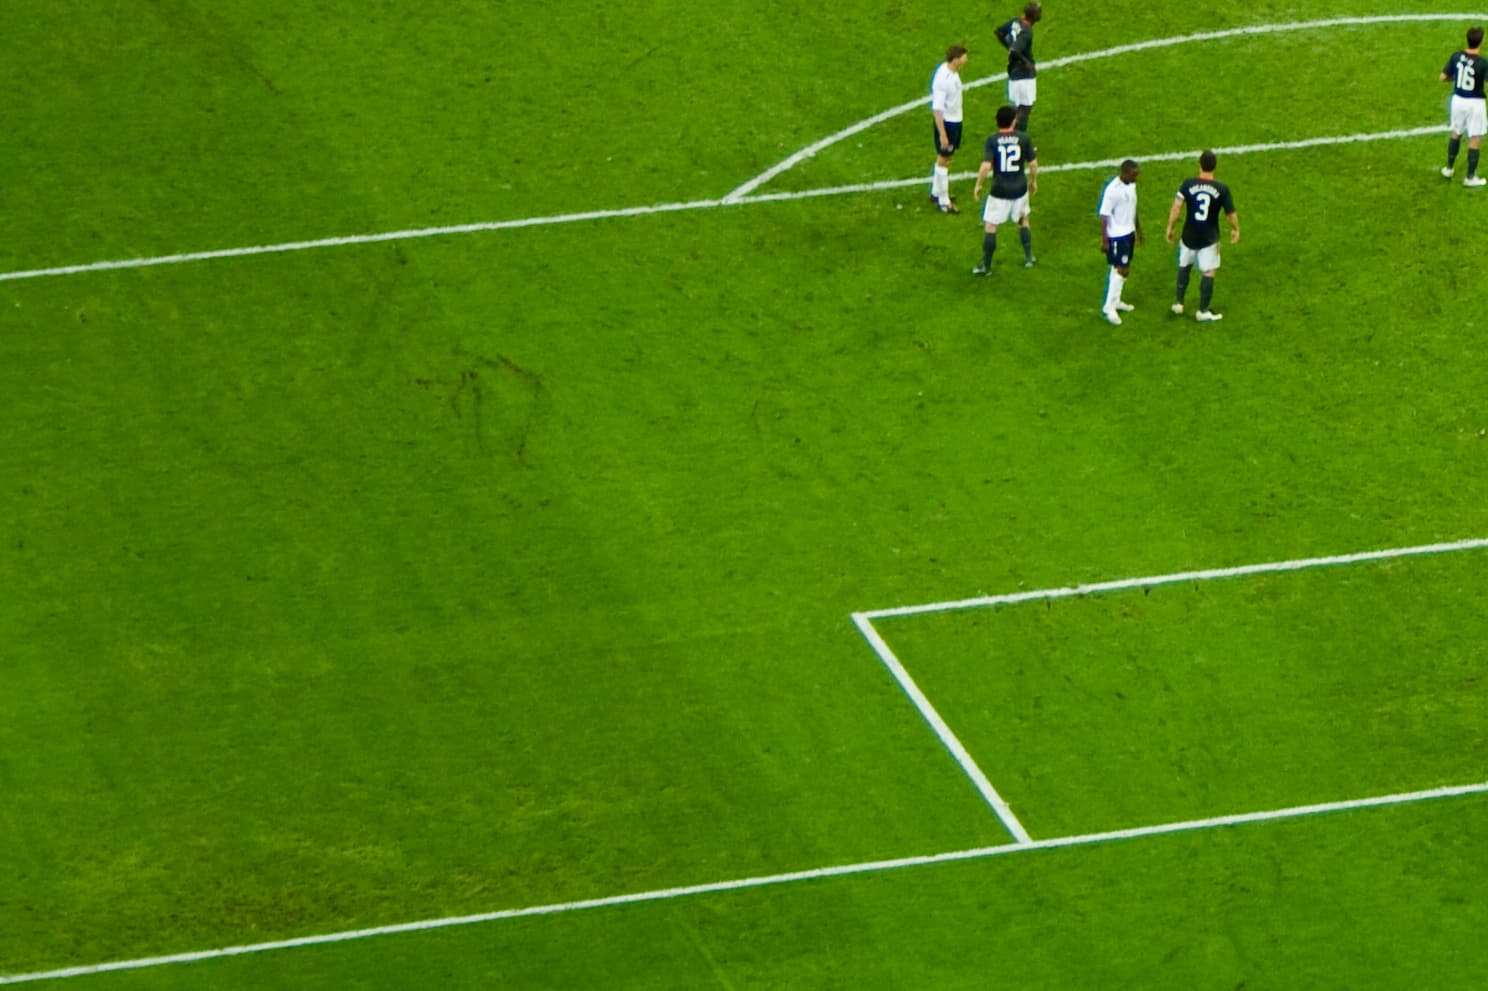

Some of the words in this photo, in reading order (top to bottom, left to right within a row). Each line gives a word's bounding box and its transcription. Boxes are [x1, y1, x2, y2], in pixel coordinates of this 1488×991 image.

[1457, 62, 1474, 90] 16
[998, 144, 1021, 172] 12
[1195, 193, 1211, 221] 3
